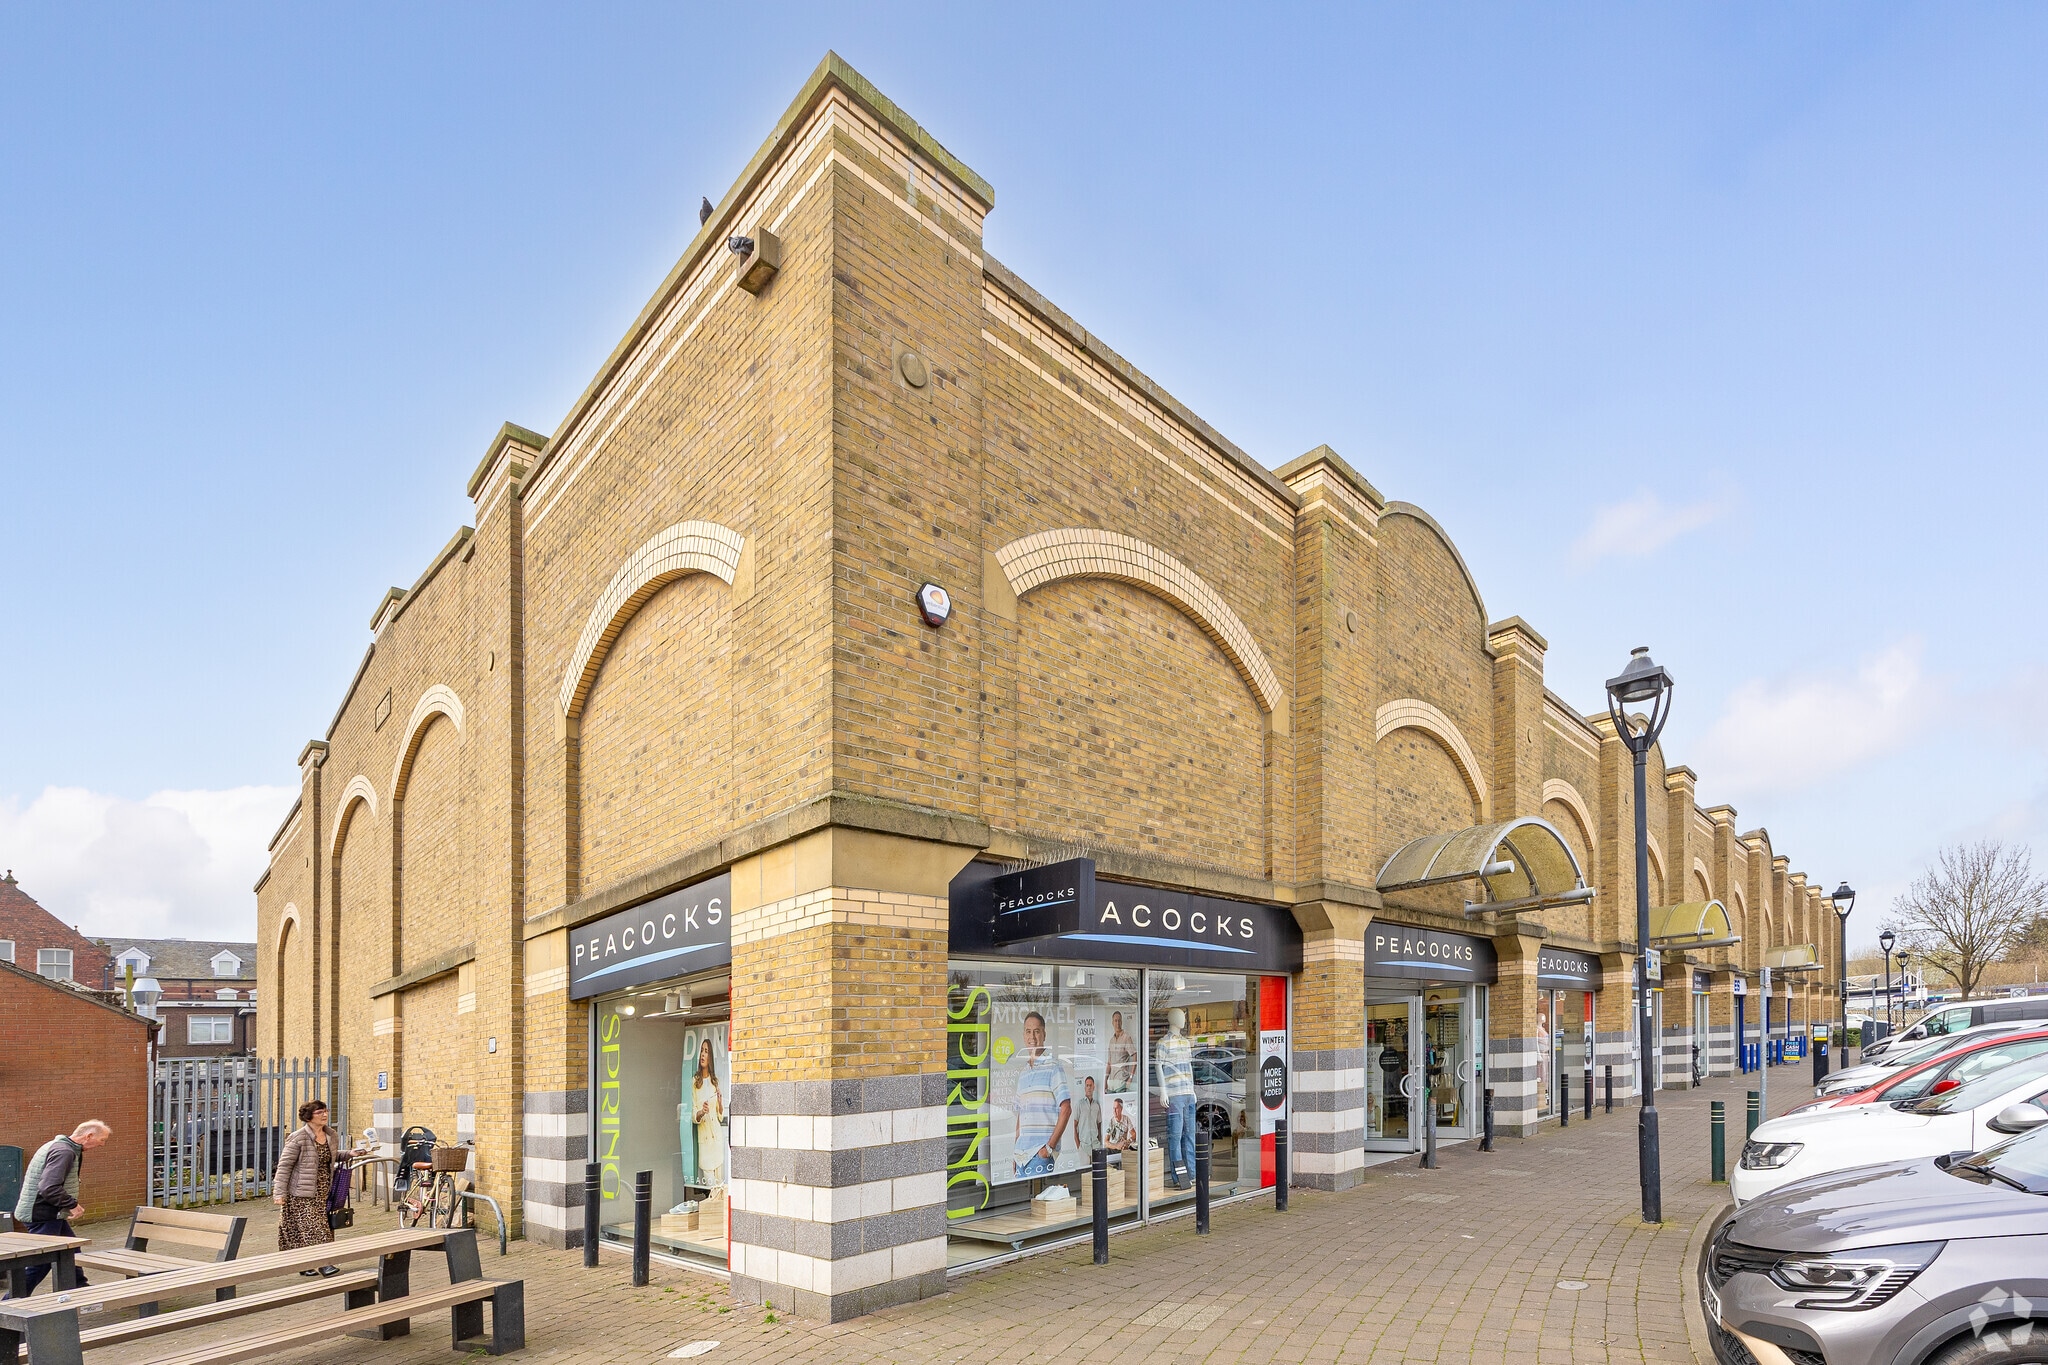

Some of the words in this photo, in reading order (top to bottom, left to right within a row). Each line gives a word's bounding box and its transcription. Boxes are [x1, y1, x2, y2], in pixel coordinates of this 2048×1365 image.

[1000, 887, 1075, 910] PEACOCKS
[1100, 901, 1254, 939] ACOCKS
[575, 898, 722, 966] PEACOCKS
[1375, 935, 1473, 961] PEACOCKS
[993, 1005, 1074, 1025] MICAEL
[995, 1045, 1011, 1055] £16
[1262, 1035, 1285, 1044] WINTER
[1264, 1068, 1282, 1078] MORE
[1264, 1078, 1282, 1088] LINES
[946, 984, 992, 1219] SPRING
[1264, 1088, 1283, 1097] ADDED
[601, 1014, 621, 1200] SPRING
[992, 1160, 1075, 1181] PEACOCKS
